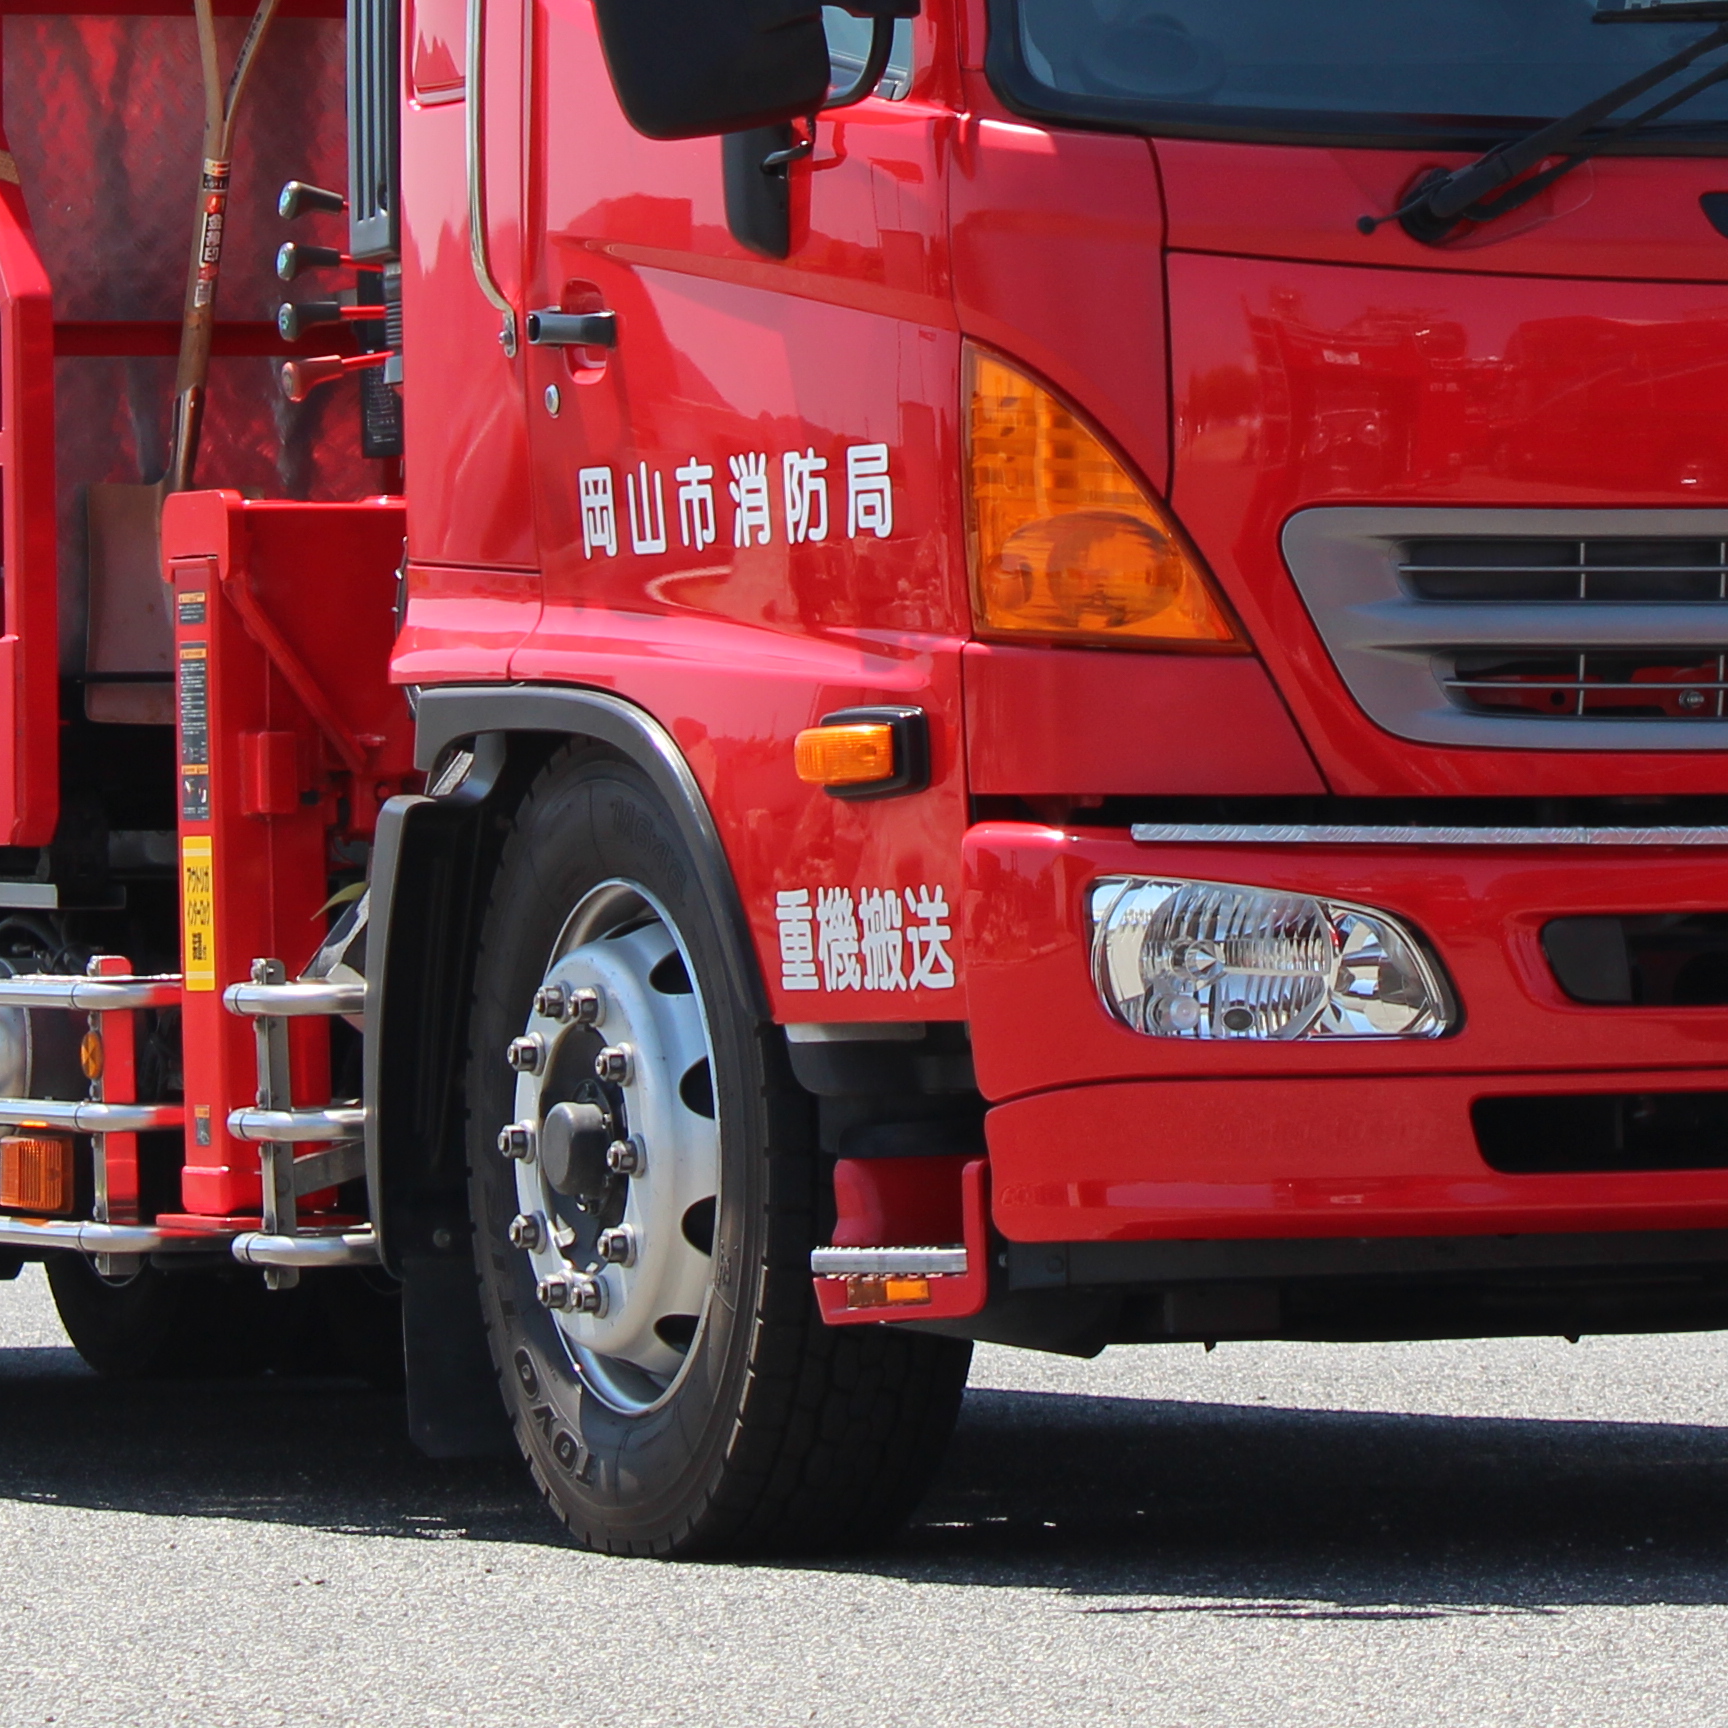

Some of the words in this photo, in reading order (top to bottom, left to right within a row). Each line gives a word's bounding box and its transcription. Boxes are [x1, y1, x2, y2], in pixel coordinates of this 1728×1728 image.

[577, 441, 896, 560] 岡山市消防局
[775, 884, 956, 993] 重機搬送
[513, 1344, 598, 1488] TOYO
